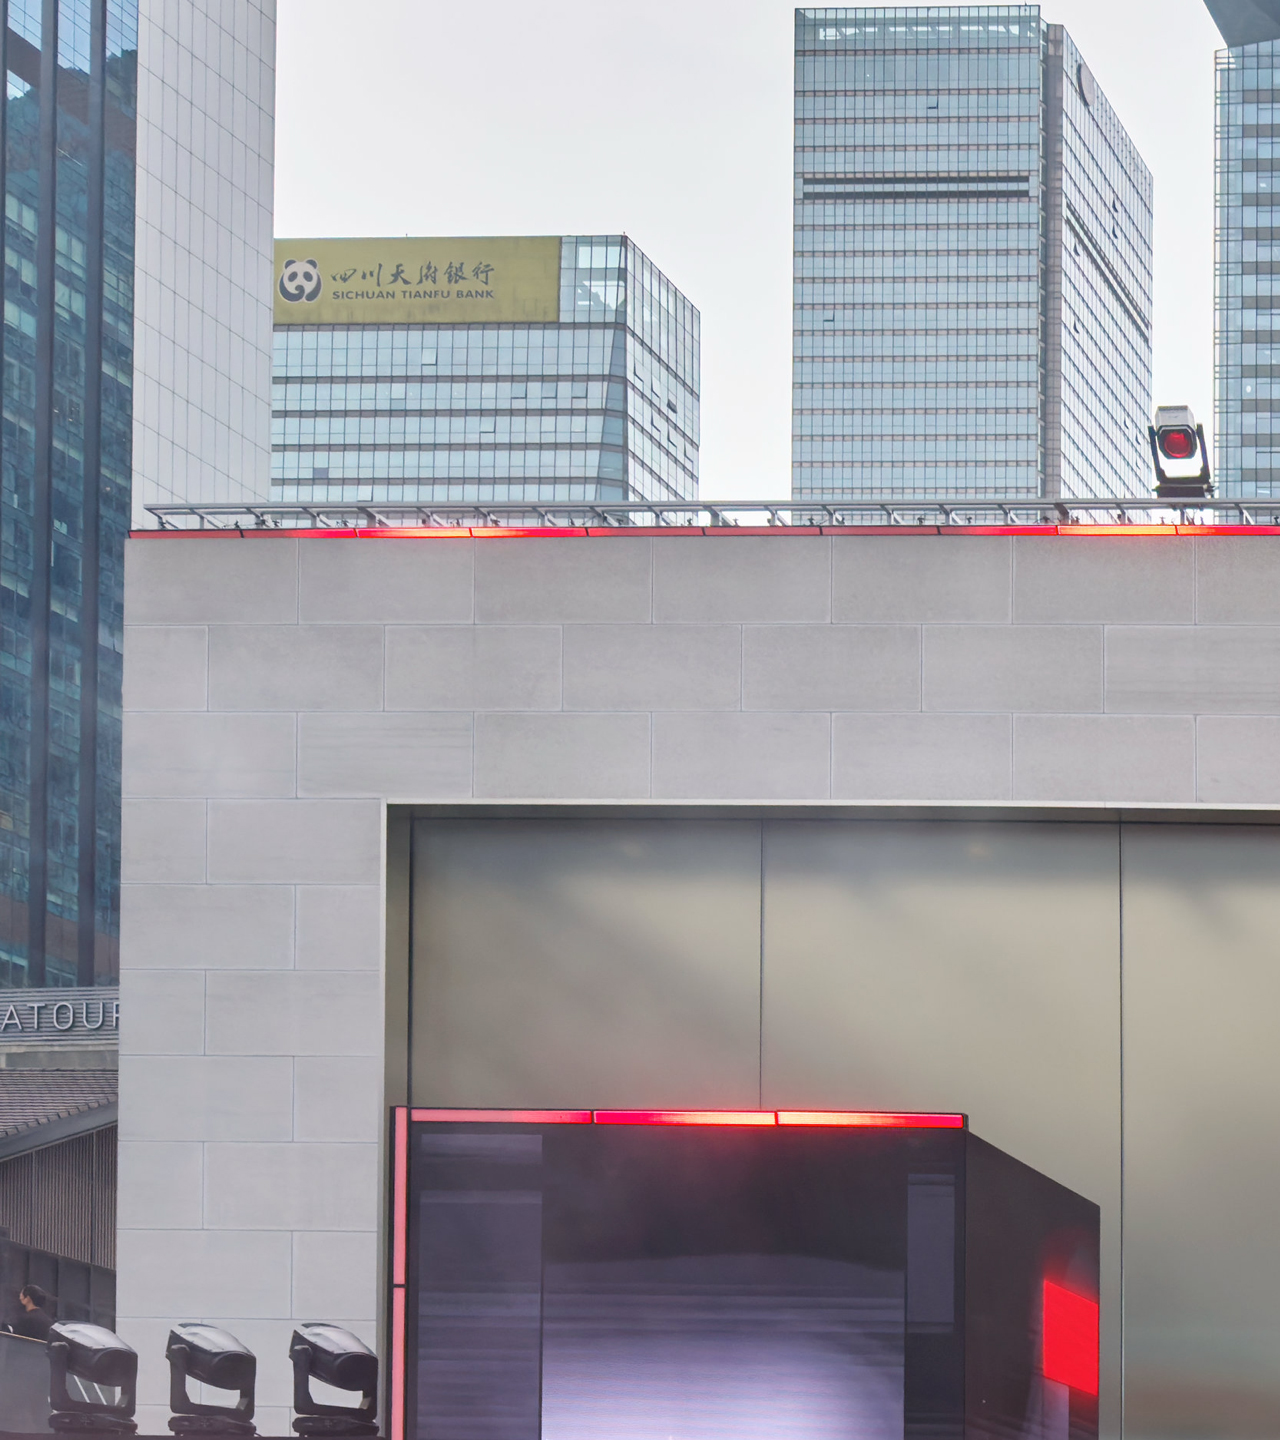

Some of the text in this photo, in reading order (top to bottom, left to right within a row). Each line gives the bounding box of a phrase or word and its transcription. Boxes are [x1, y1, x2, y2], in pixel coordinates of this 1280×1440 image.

[332, 289, 495, 300] SICHUAN TIANFU BANK
